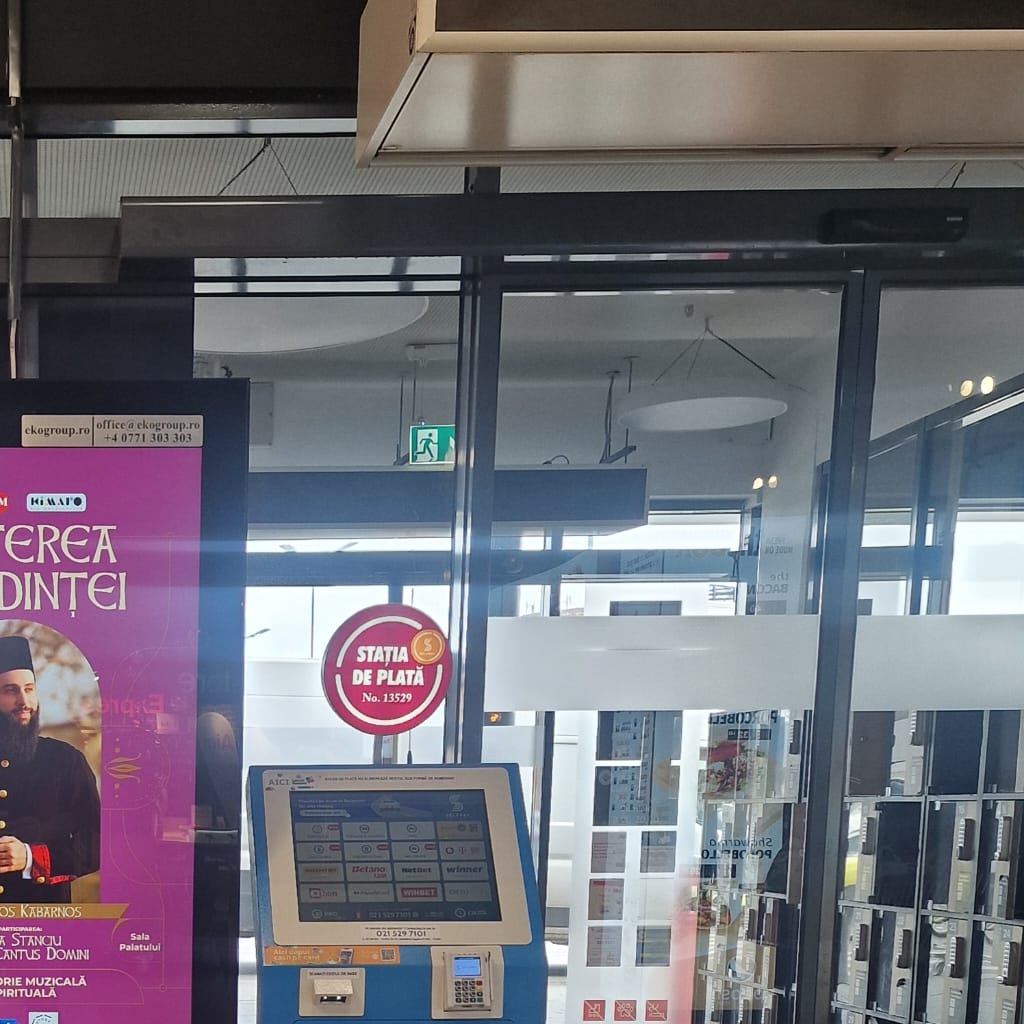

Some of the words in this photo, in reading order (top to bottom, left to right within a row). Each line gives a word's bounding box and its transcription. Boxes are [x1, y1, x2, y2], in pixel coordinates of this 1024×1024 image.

[25, 424, 90, 435] ekogroup.ro
[104, 434, 117, 442] +4
[121, 433, 146, 443] 0771
[151, 433, 169, 442] 303
[173, 433, 192, 442] 303
[356, 646, 409, 666] STAȚIA
[352, 669, 372, 685] DE
[376, 665, 425, 686] PLATĂ
[362, 692, 380, 702] No.
[383, 693, 412, 702] 13529
[130, 933, 150, 941] Sala
[119, 943, 161, 951] Palatului
[25, 975, 87, 987] MUZICALĂ
